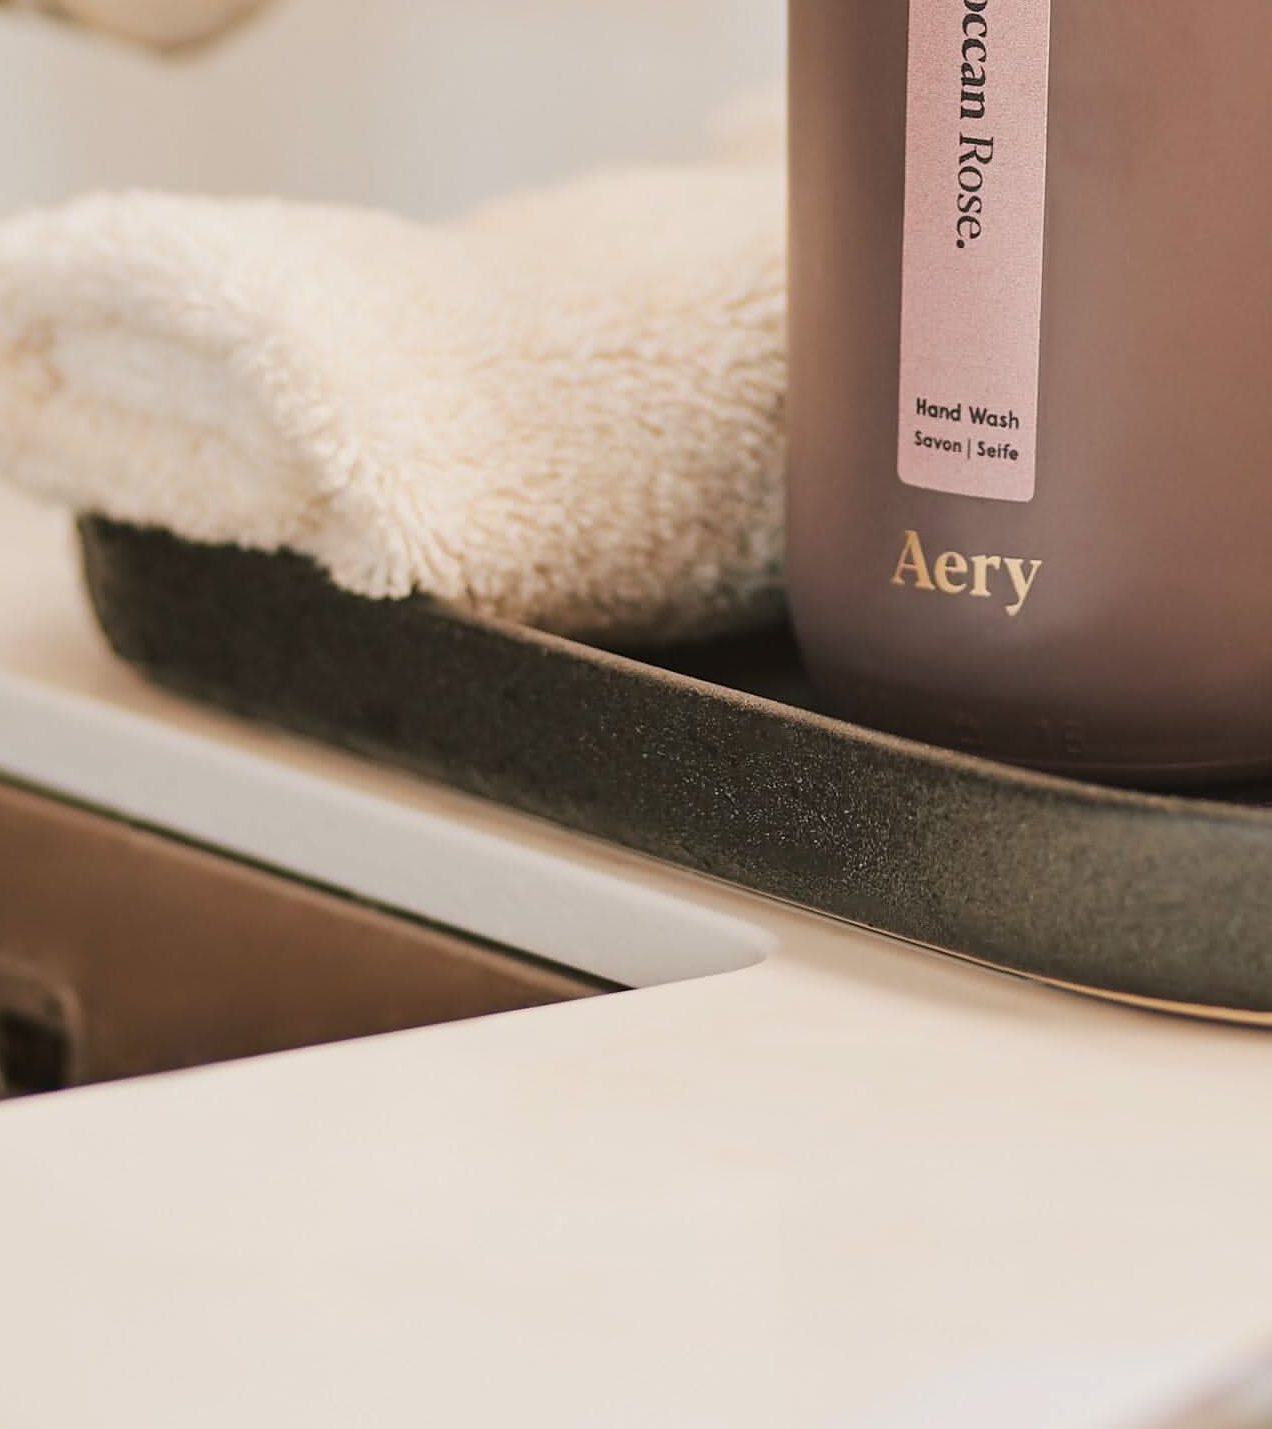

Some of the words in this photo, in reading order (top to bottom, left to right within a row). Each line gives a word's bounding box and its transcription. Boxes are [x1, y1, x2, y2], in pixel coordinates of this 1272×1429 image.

[956, 132, 994, 249] Rose.
[915, 397, 962, 422] Hand
[968, 405, 1020, 430] Wash
[914, 430, 962, 453] Savon
[976, 441, 1019, 461] Seife
[890, 529, 1043, 617] Aery
